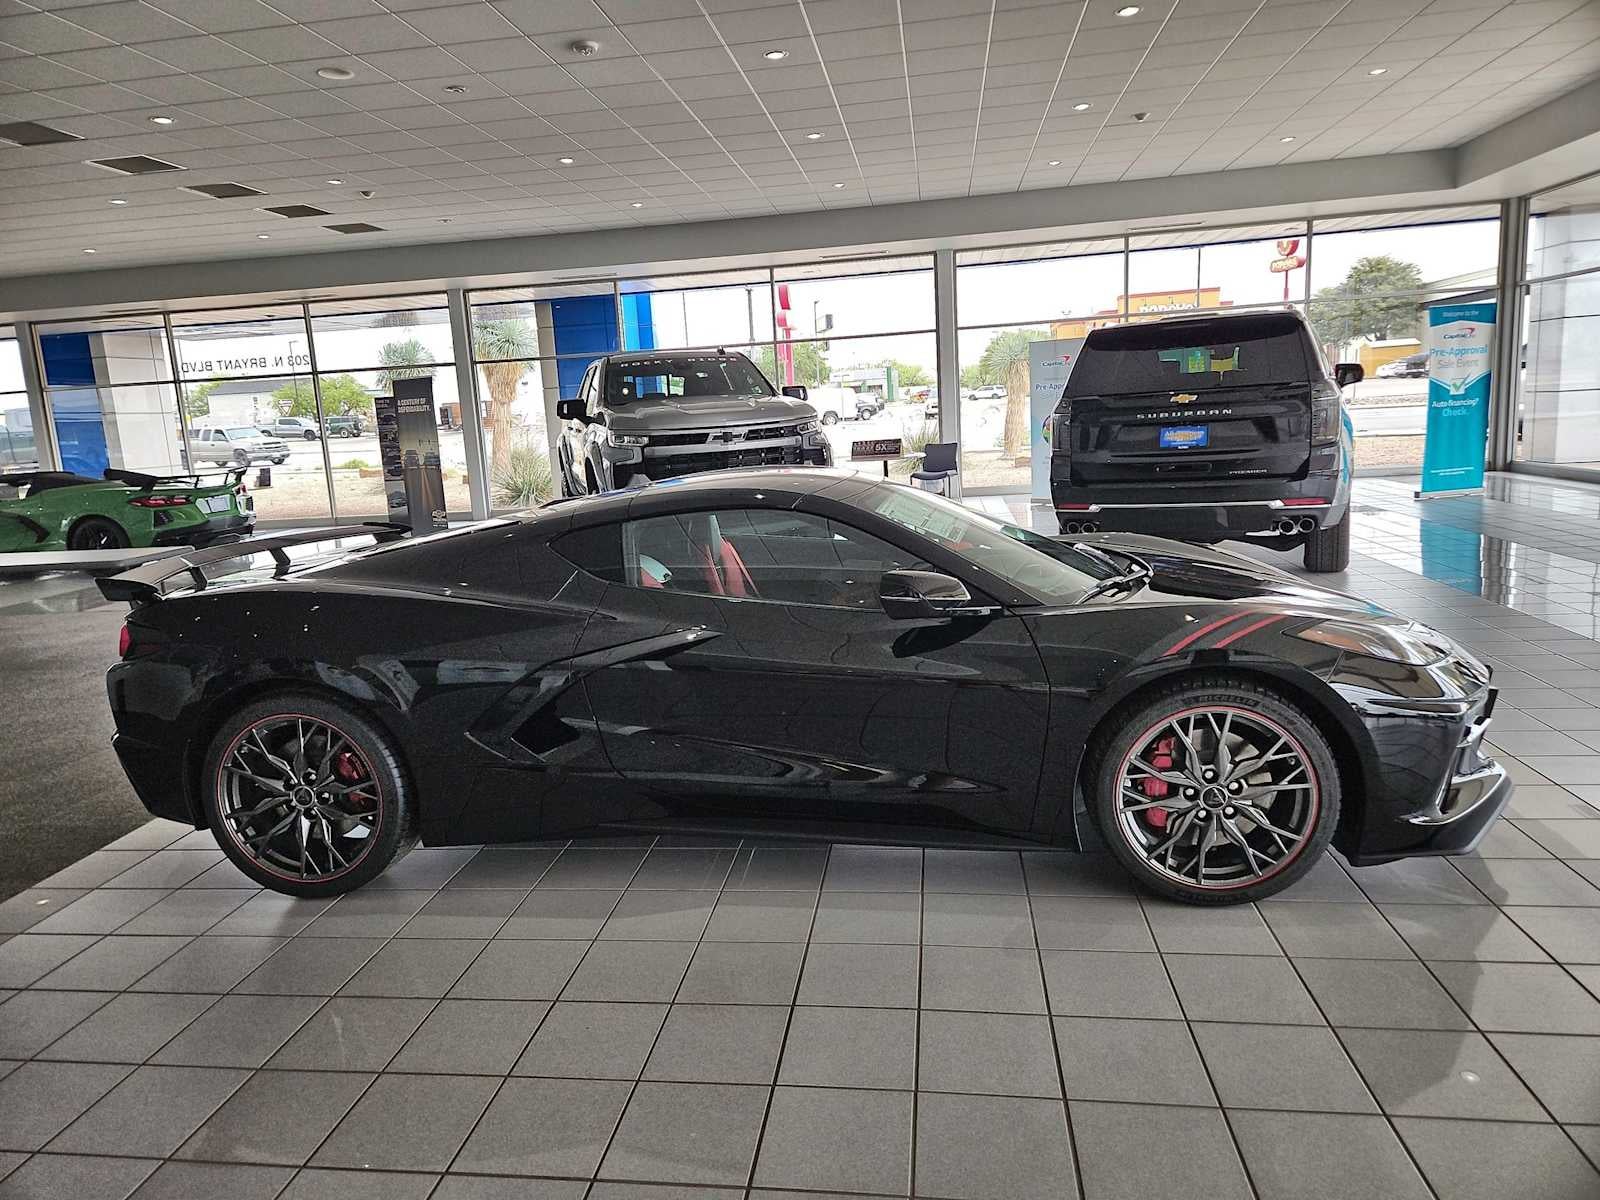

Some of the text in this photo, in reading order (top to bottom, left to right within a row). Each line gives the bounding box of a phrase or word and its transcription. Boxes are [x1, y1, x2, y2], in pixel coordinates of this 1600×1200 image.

[1430, 345, 1488, 357] Pre-Approval
[1136, 408, 1232, 419] SUBURBAN
[1199, 694, 1259, 707] MICHELIN
